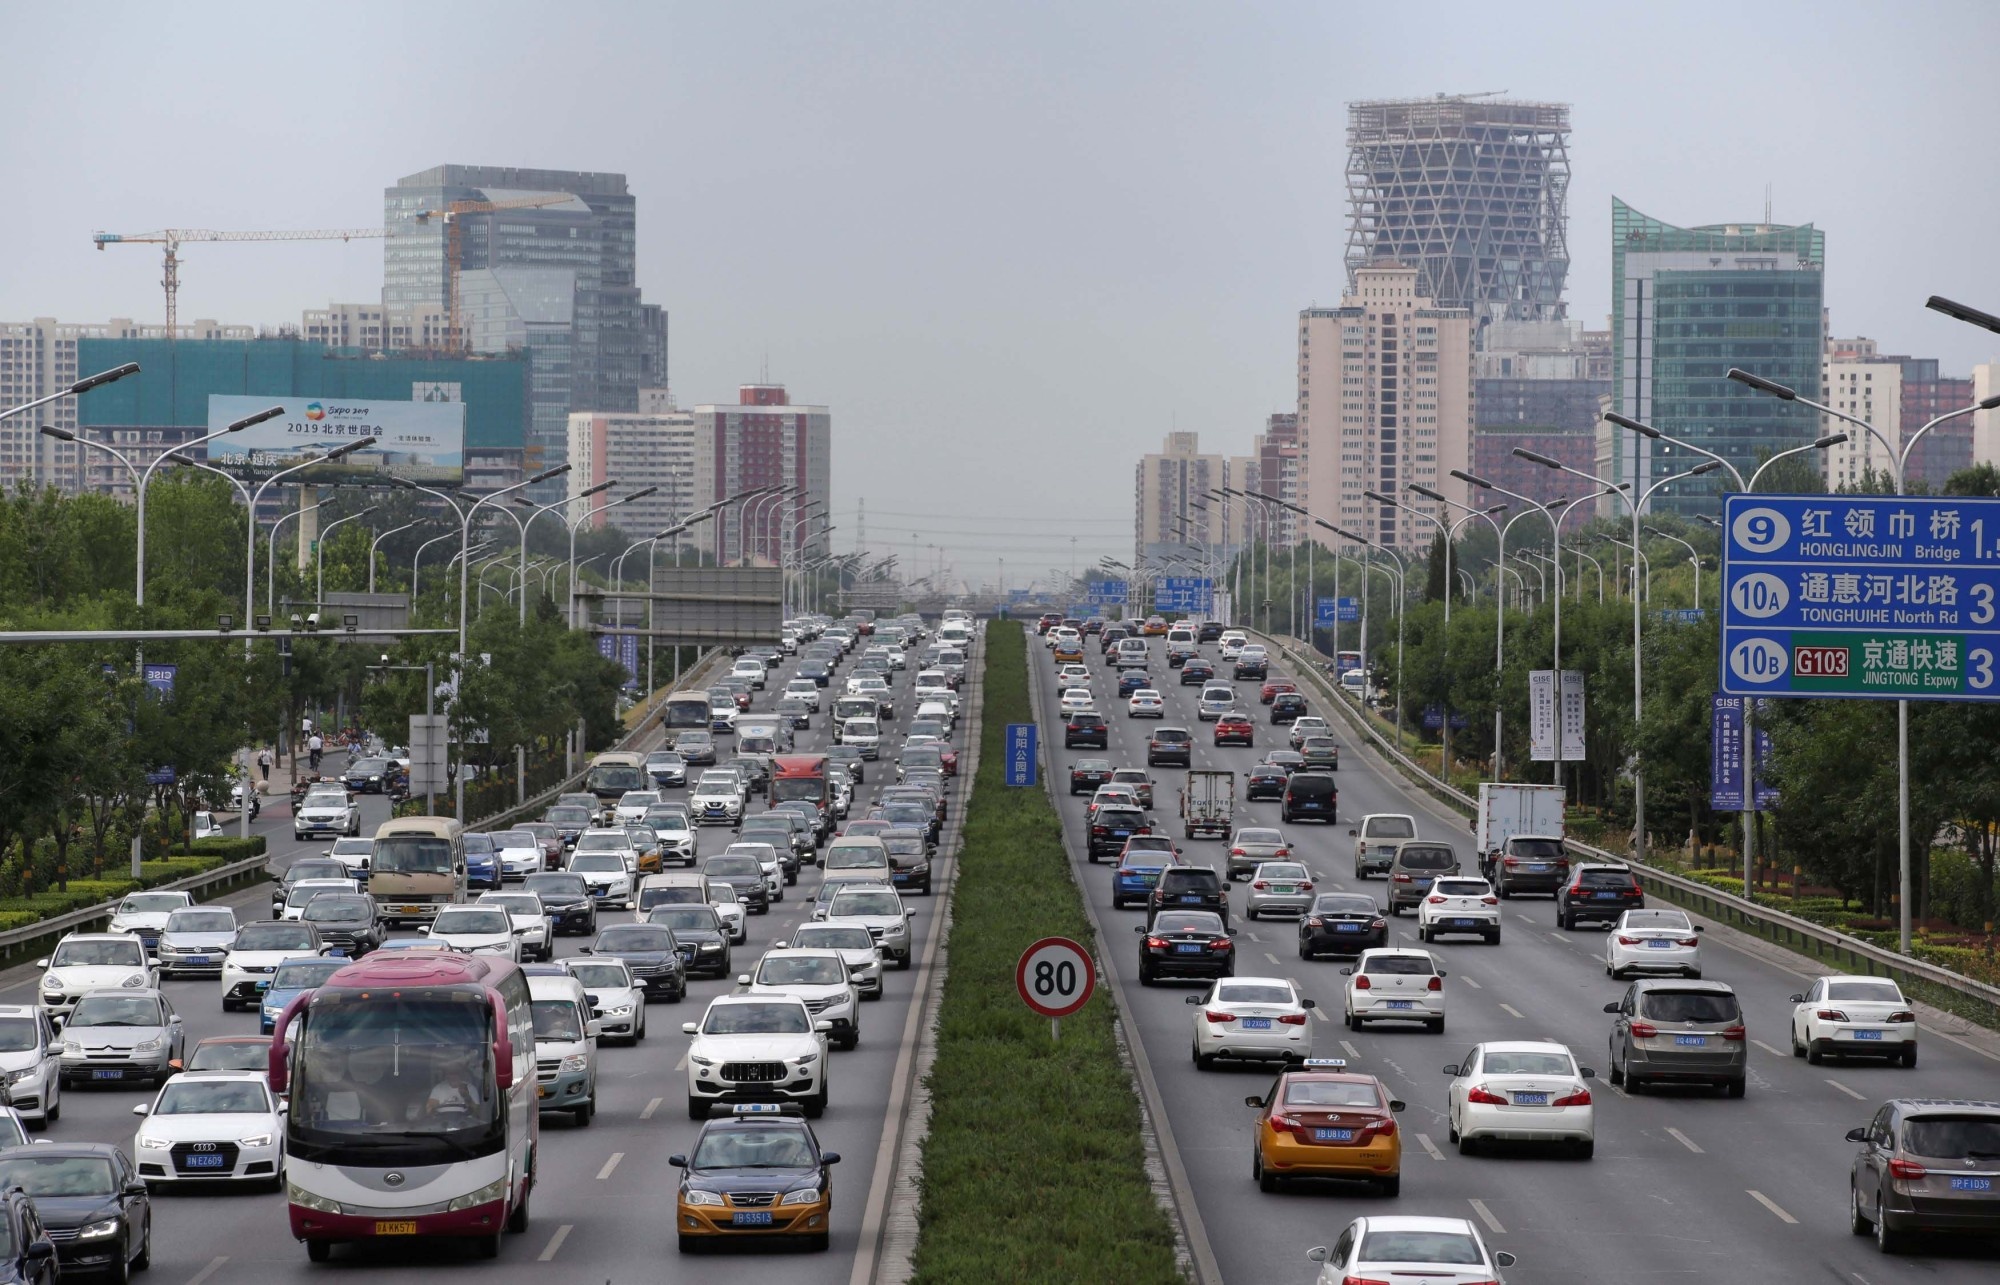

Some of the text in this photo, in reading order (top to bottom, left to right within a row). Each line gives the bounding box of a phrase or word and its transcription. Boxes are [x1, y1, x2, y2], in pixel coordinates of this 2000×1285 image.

[1747, 516, 1775, 545] 9
[1801, 508, 1961, 540] 红领巾桥
[1970, 518, 2000, 559] 1.
[1800, 542, 1961, 561] HONGLINGJIN Bridge
[1739, 581, 1780, 610] 10A
[1799, 572, 1959, 606] 通惠河北路
[1969, 583, 1995, 624] 3
[1800, 608, 1958, 624] TONGHUIHE North Rd
[1739, 645, 1779, 675] 10B
[1797, 649, 1847, 673] G103
[1862, 638, 1958, 671] 京通快速
[1968, 648, 1994, 689] 3
[1532, 675, 1551, 683] CISE
[1862, 671, 1959, 689] JINGTONG Expwy
[1715, 698, 1740, 708] CISE
[1015, 726, 1028, 784] 朝阳公园桥
[1035, 960, 1076, 996] 80
